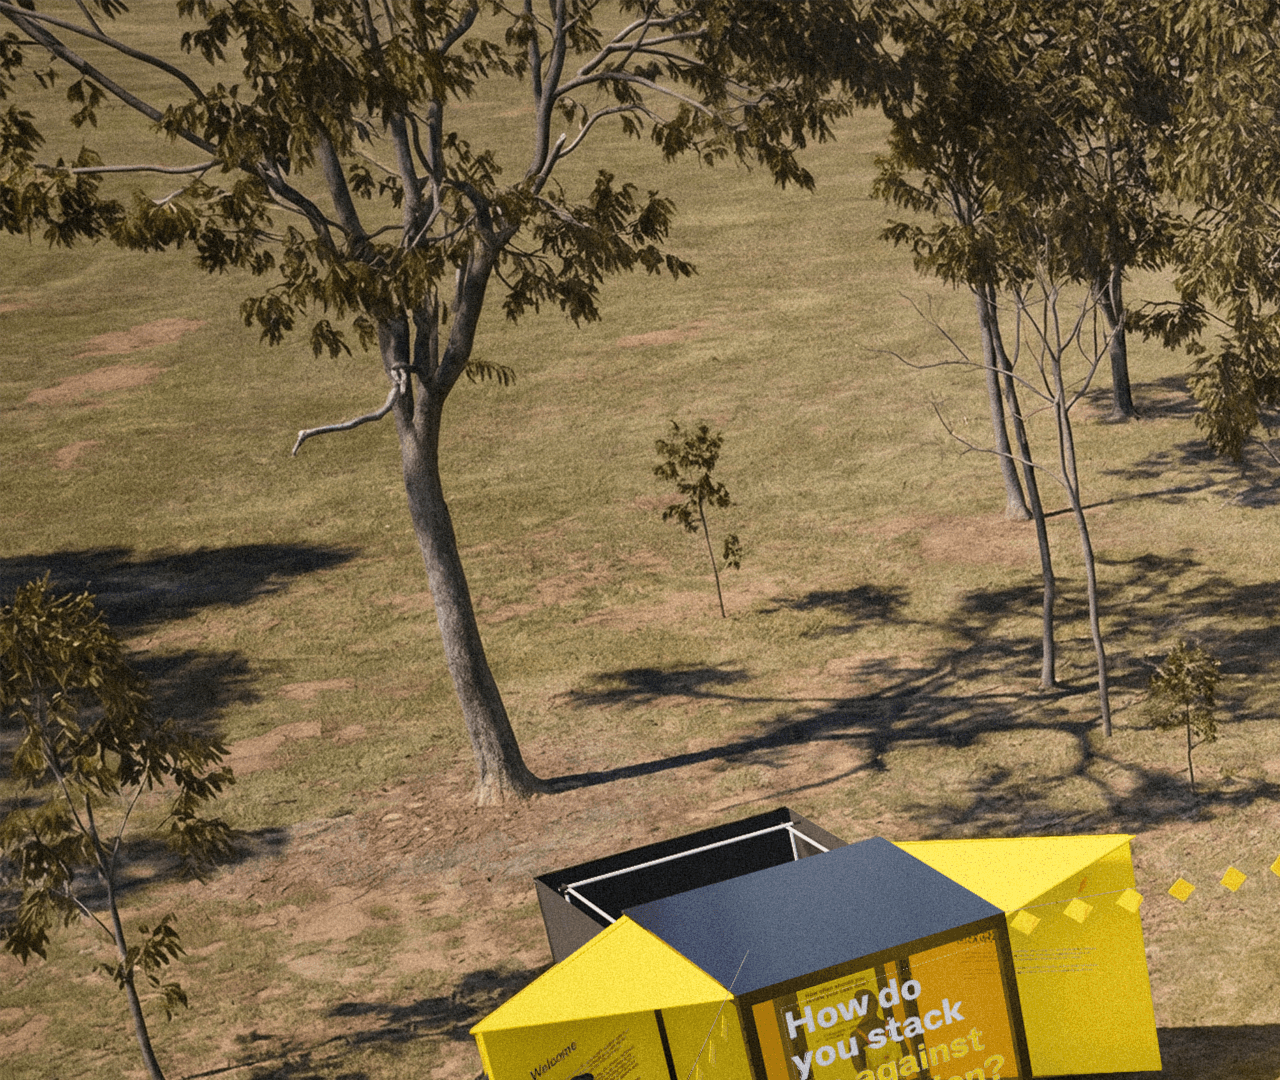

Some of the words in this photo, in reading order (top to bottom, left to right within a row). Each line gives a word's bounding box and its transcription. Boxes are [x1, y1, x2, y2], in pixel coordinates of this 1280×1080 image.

[785, 994, 869, 1040] How
[878, 978, 922, 1008] do
[867, 998, 965, 1049] stack
